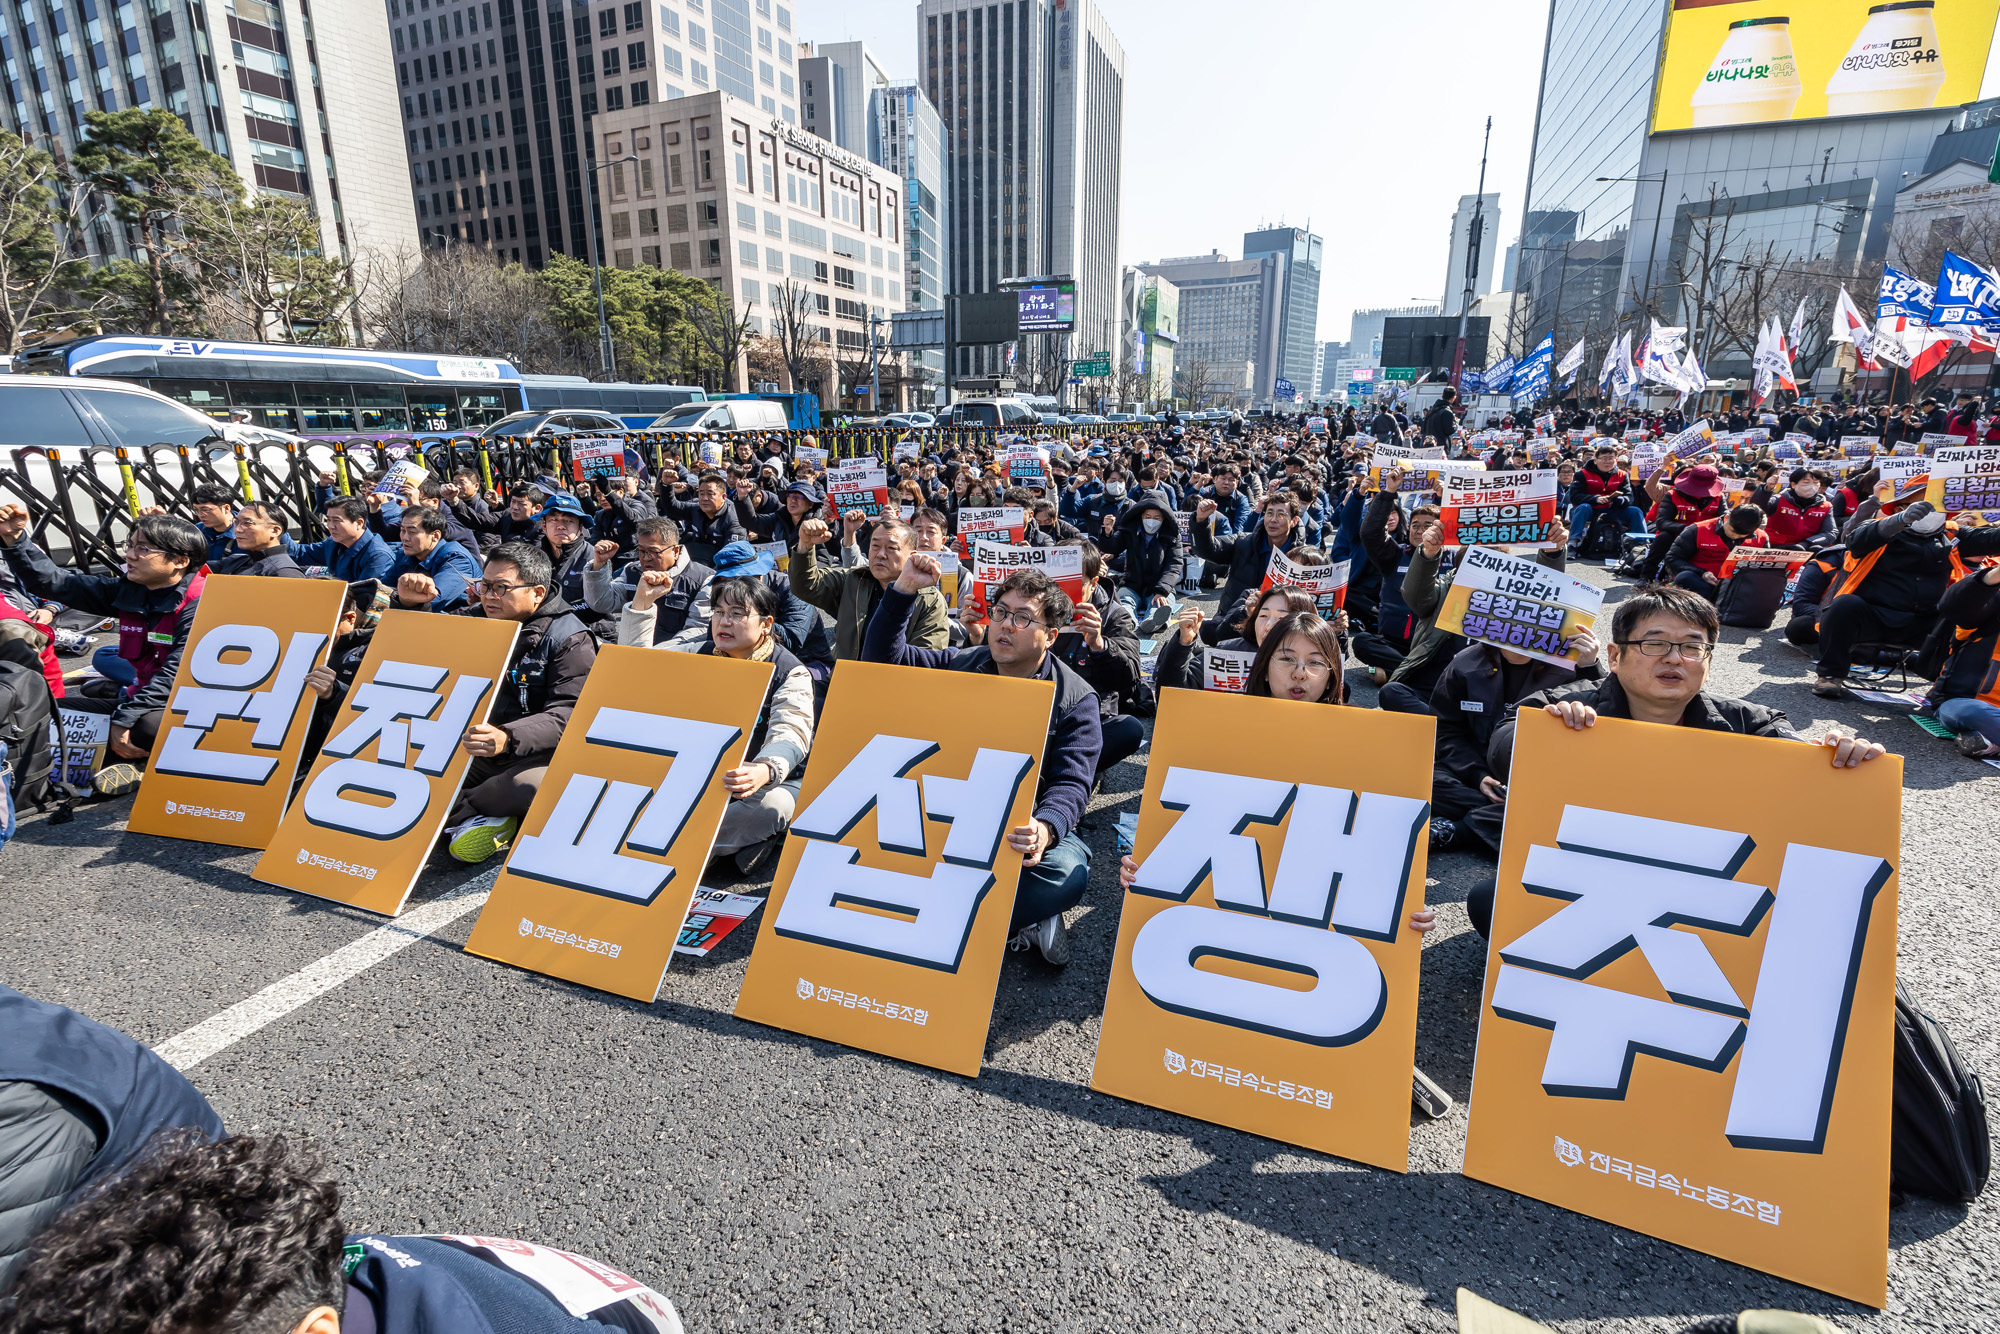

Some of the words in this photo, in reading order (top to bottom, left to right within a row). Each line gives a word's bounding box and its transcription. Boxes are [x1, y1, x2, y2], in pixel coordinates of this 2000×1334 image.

[1059, 10, 1070, 69] 서울신문
[1871, 42, 1889, 50] 빙그레
[1892, 38, 1921, 49] 무가당
[1731, 57, 1752, 66] 빙그레
[791, 128, 818, 152] SEOUL
[819, 139, 850, 166] FINANCE
[173, 342, 210, 355] EV
[427, 419, 447, 431] 150
[573, 442, 584, 450] 모든
[585, 440, 607, 449] 노동자의
[1377, 446, 1410, 459] 진짜사장
[580, 456, 614, 469] 투쟁으로
[1009, 459, 1041, 468] 투쟁으로
[1883, 459, 1926, 469] 진짜사장
[1937, 449, 1999, 462] 진짜사장
[828, 472, 839, 482] 모든
[840, 471, 866, 482] 노동자의
[1009, 468, 1044, 477] 쟁취하자!
[1448, 475, 1475, 491] 모든
[1479, 473, 1532, 490] 노동자의
[830, 482, 859, 492] 노동기본권
[834, 491, 875, 505] 투쟁으로
[1450, 490, 1515, 505] 노동기본권
[960, 512, 973, 522] 모든
[974, 509, 1003, 520] 노동자의
[1457, 503, 1539, 524] 투쟁으로
[960, 520, 995, 531] 노동기본권
[1457, 522, 1550, 544] 쟁취하자!
[977, 547, 996, 565] 모든
[998, 549, 1047, 566] 노동자의
[1467, 550, 1538, 580] 진짜사장
[1272, 553, 1288, 574] 모든
[1289, 567, 1333, 580] 노동자의
[1494, 577, 1561, 601] 나와라!
[1468, 590, 1565, 630] 원청교섭
[1462, 614, 1574, 656] 쟁취하자!
[1208, 655, 1240, 674] 모든
[155, 624, 327, 786] 원
[304, 660, 492, 840] 청
[177, 803, 246, 822] 전국금속노동조합
[507, 707, 742, 905] 교
[774, 734, 1035, 974] 섭
[308, 853, 378, 881] 전국금속노동조합
[693, 890, 728, 903] 자의
[1130, 766, 1430, 1048] 쟁
[534, 924, 622, 958] 전국금속노동조합
[1491, 804, 1894, 1155] 취
[817, 986, 929, 1026] 전국금속노동조합
[1190, 1058, 1334, 1110] 전국금속노동조합
[1589, 1150, 1782, 1226] 전국금속노동조합
